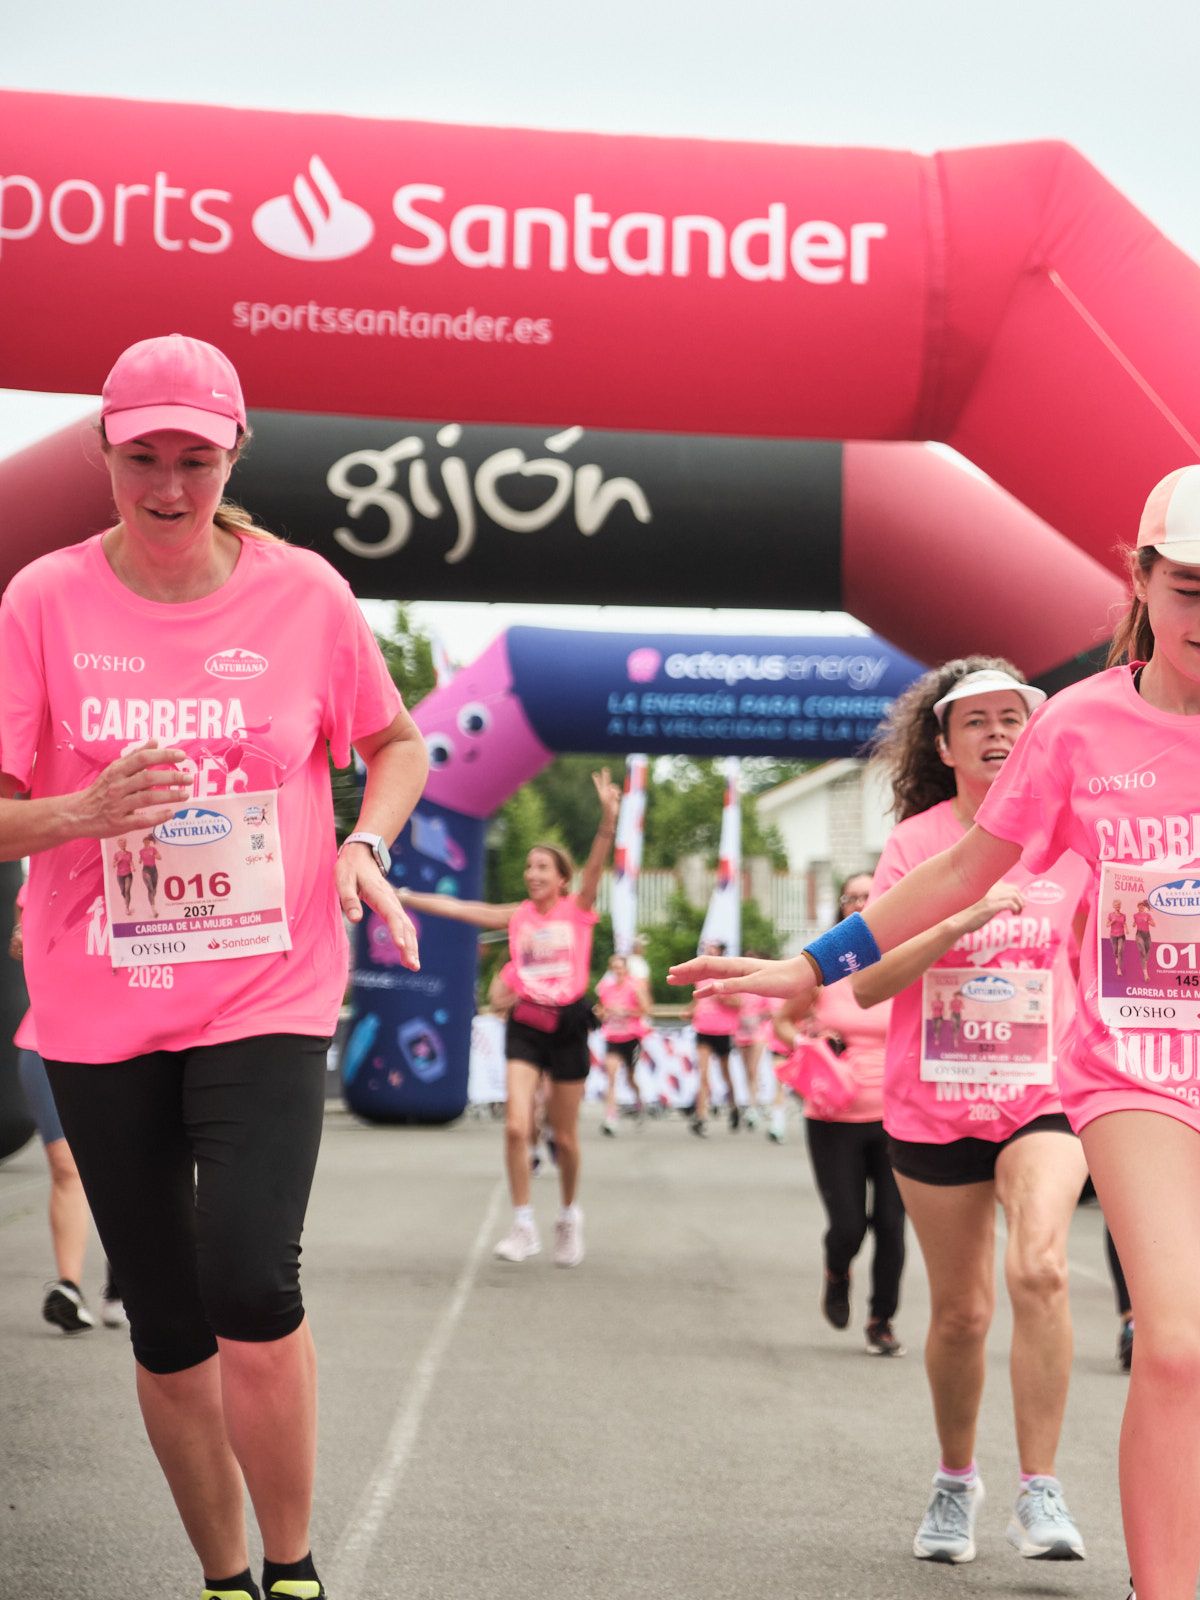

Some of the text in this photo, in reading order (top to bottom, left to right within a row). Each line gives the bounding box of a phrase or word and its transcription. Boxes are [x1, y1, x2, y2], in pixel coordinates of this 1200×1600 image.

[390, 183, 888, 286] Santander
[232, 299, 552, 346] sportssantander.es
[325, 422, 652, 564] gijón
[73, 652, 146, 673] OYSHO
[209, 659, 264, 673] ASTURIANA
[607, 691, 639, 715] LA
[739, 694, 801, 717] PARA
[81, 696, 248, 742] CARRERA
[1088, 771, 1156, 795] OYSHO
[159, 823, 227, 839] ASTURIANA
[163, 871, 231, 902] 016
[1114, 880, 1145, 893] SUMA
[184, 904, 215, 918] 2037
[135, 913, 261, 935] CARRERA DE LA MUJER GIJÓN
[131, 934, 270, 956] OYSHO Santander
[128, 965, 174, 989] 2026
[1126, 986, 1165, 998] CARRERA
[1167, 987, 1178, 998] DE
[1180, 987, 1191, 998] LA
[1119, 1005, 1176, 1019] OYSHO
[963, 1021, 1012, 1041] 016
